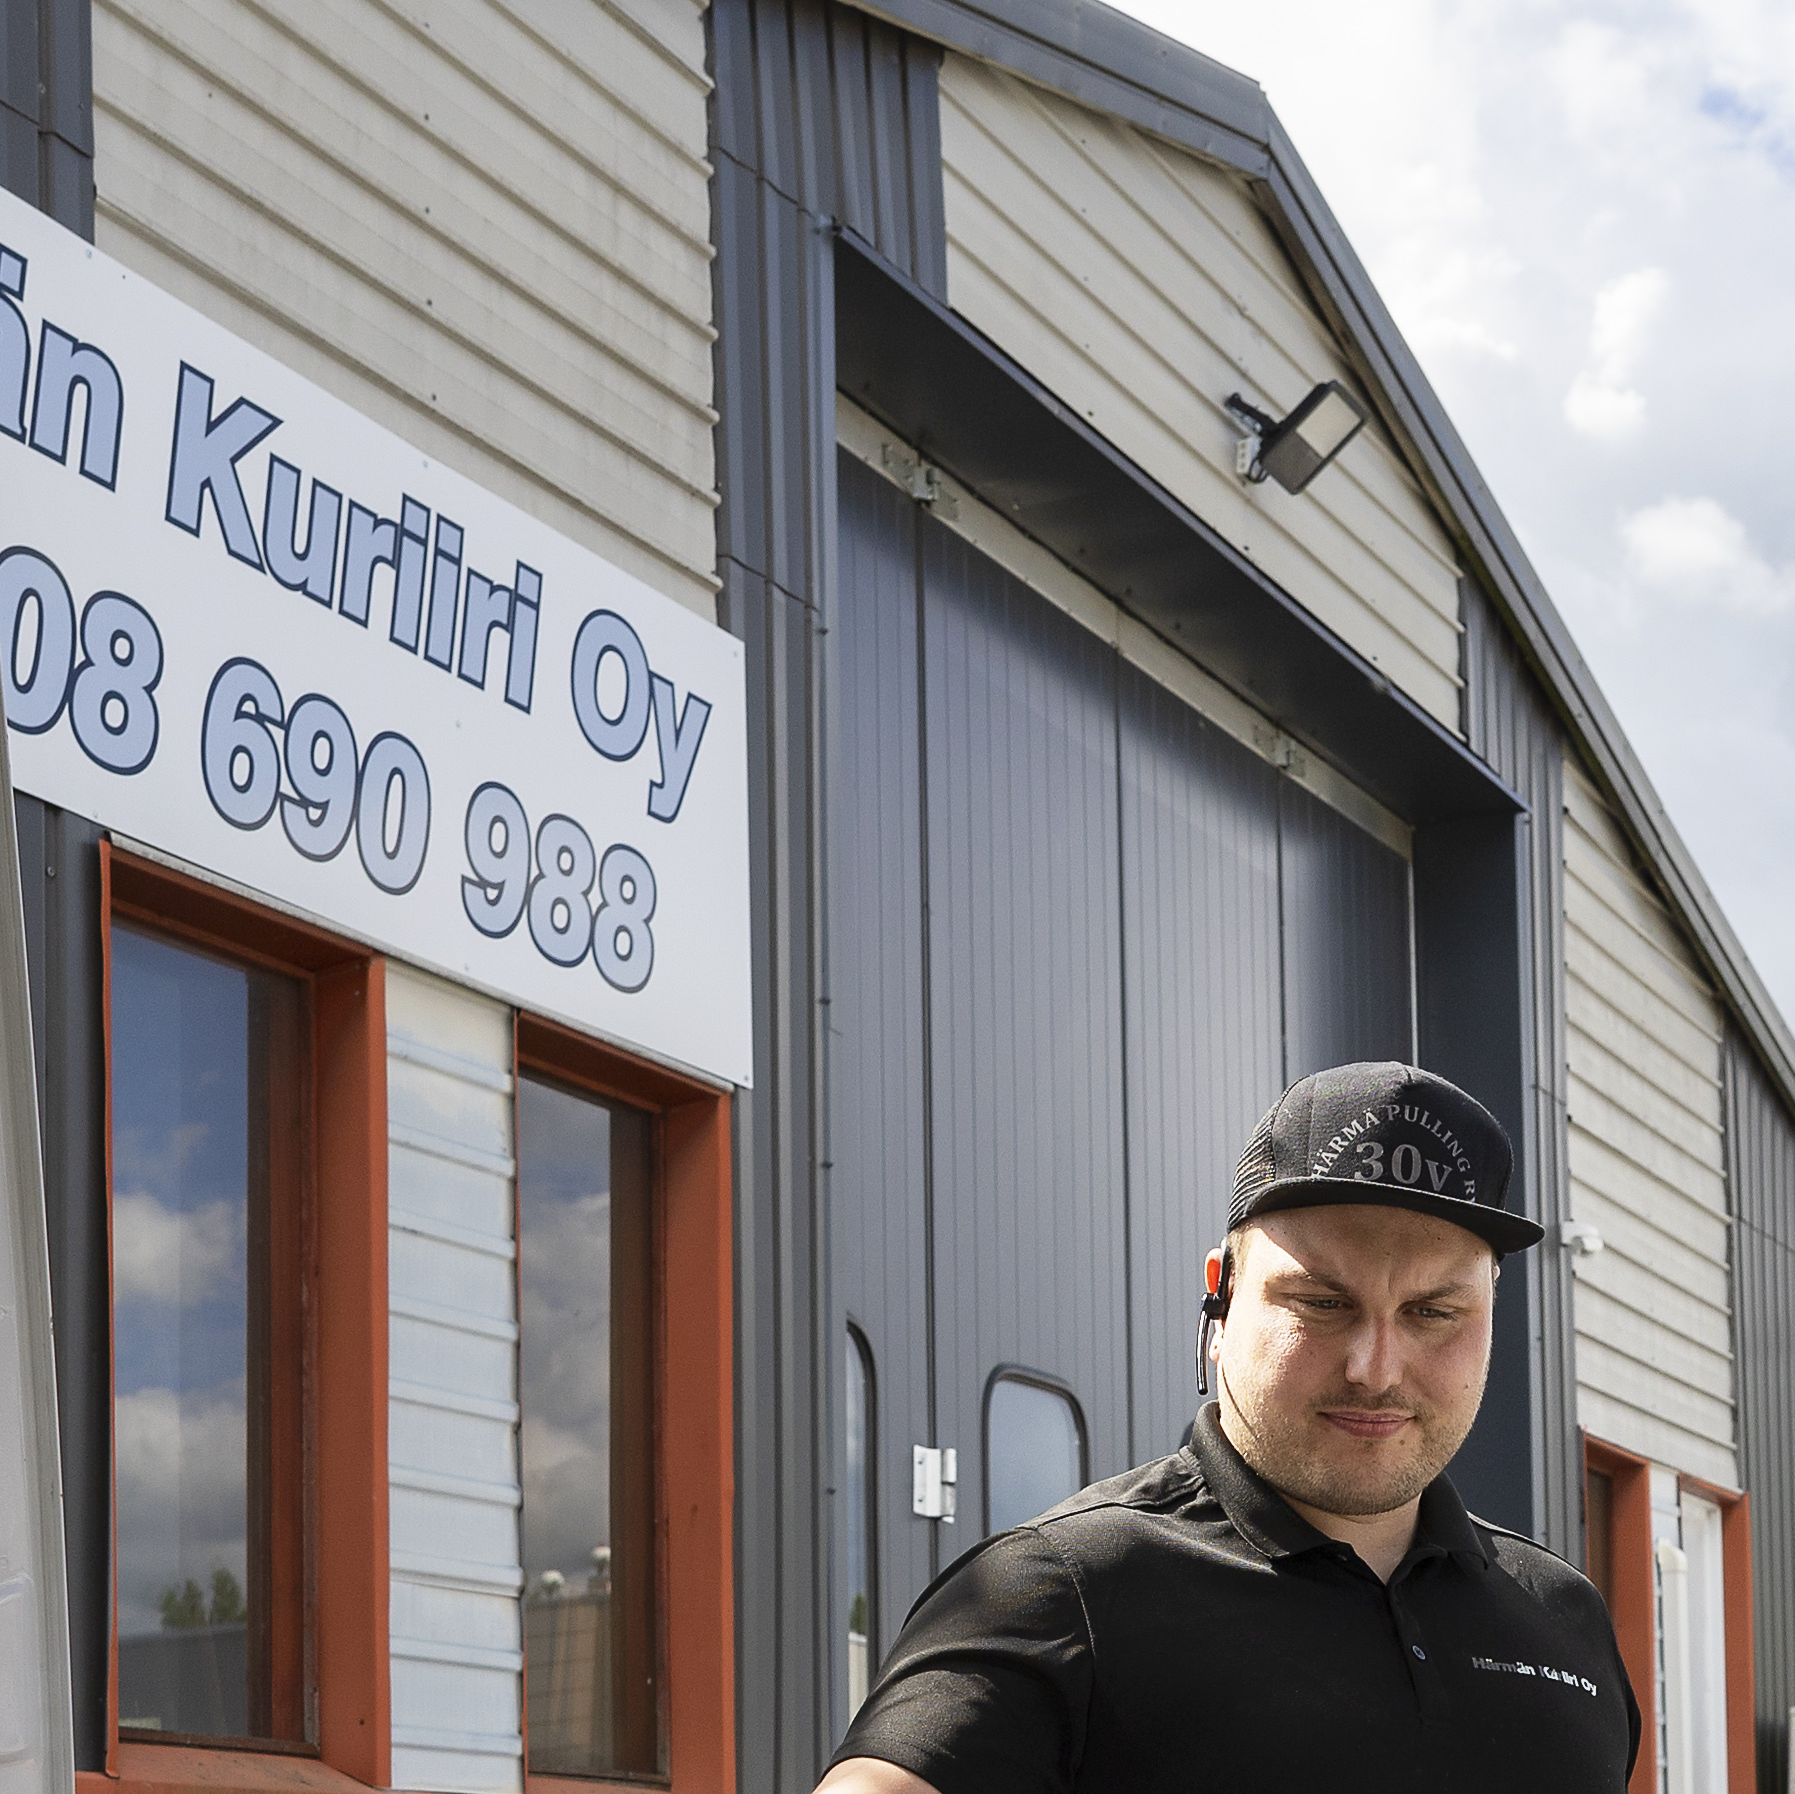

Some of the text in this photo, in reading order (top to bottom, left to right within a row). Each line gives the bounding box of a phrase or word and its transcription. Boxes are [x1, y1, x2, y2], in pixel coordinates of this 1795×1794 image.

[165, 360, 544, 713] Kuriiri
[571, 608, 712, 823] Oy
[201, 657, 431, 895] 690
[461, 781, 657, 994] 988
[1312, 1108, 1381, 1179] HÄRMÄ
[1385, 1104, 1471, 1173] PULLING
[1471, 1656, 1536, 1676] Härmän
[1581, 1677, 1597, 1697] Oy
